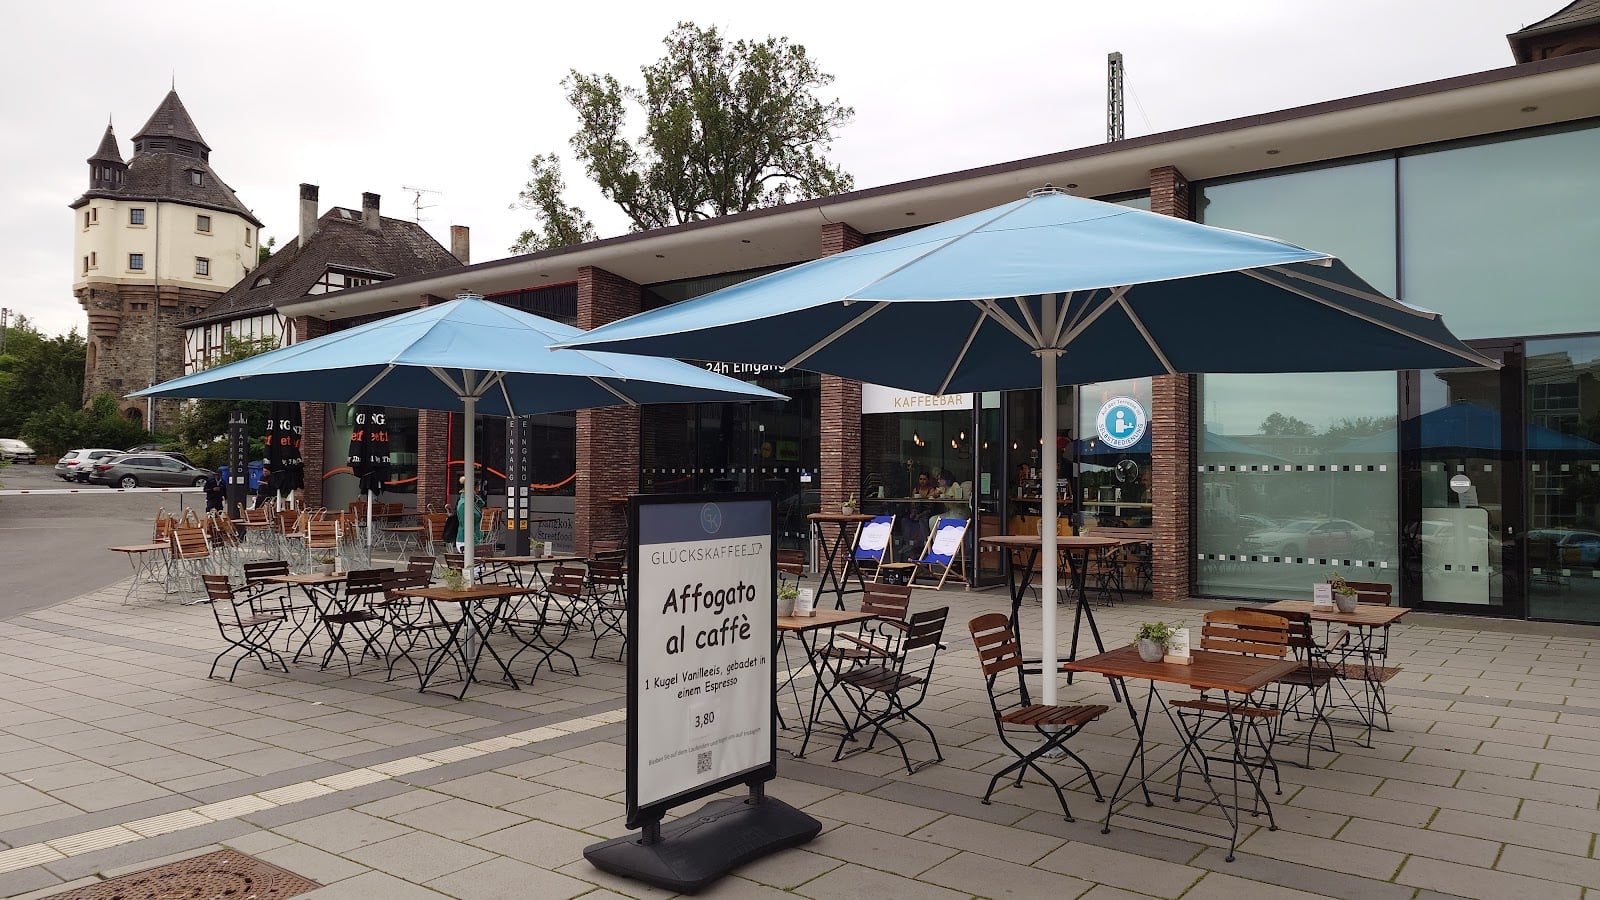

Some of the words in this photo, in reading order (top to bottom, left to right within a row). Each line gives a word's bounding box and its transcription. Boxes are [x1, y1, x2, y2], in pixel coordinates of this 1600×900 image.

[706, 362, 729, 374] 24h
[894, 395, 963, 408] KAFFEEBAR
[1098, 423, 1144, 446] SELBSTBEDIENUNG
[651, 544, 747, 565] GLÜCKSKAFFEE
[662, 580, 756, 615] Affogato
[666, 625, 685, 654] al
[695, 613, 751, 650] caffè
[645, 679, 650, 690] 1
[654, 673, 679, 690] Kugel
[682, 665, 723, 683] Vanilleeis,
[726, 657, 758, 675] gebadet
[759, 655, 766, 665] in
[677, 685, 702, 699] einem
[705, 676, 738, 693] Espresso
[695, 711, 715, 728] 3,80
